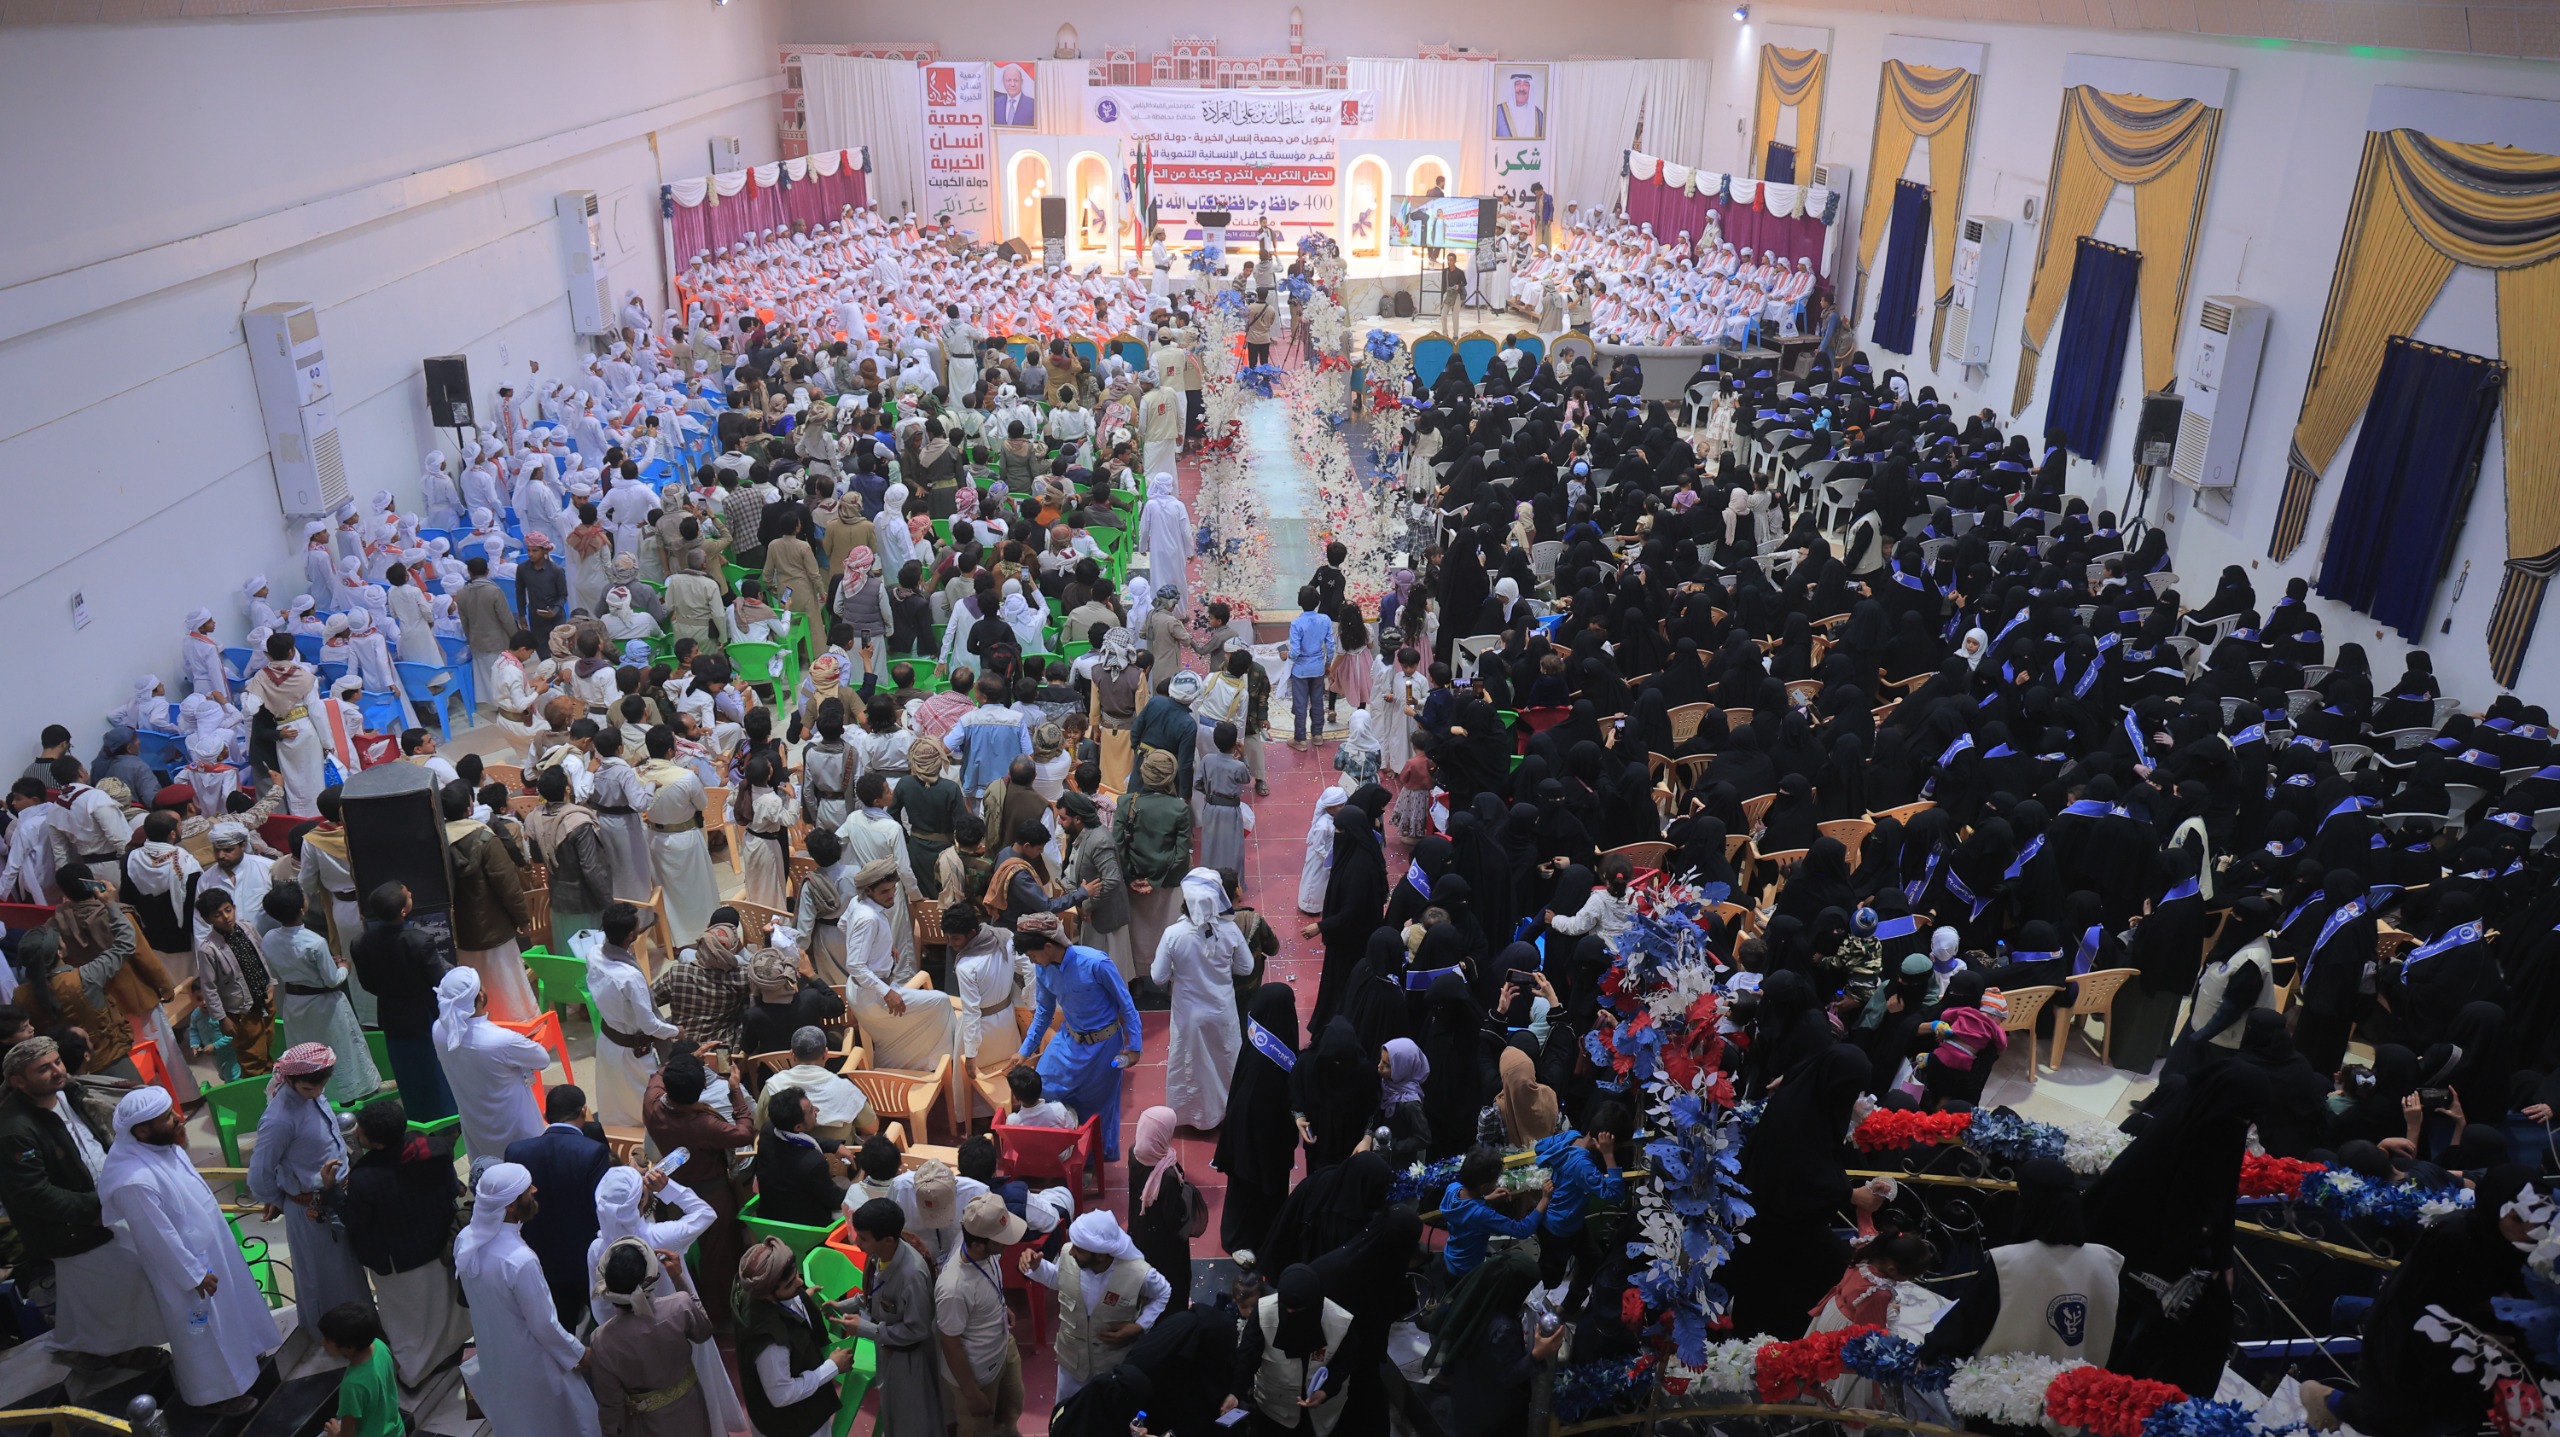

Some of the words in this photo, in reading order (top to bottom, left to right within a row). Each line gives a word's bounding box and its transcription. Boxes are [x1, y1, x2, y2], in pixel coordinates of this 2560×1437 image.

[960, 71, 981, 81] جمعية
[960, 93, 982, 103] الخيرية
[1309, 102, 1331, 112] برعاية
[928, 110, 982, 129] جمعية
[1311, 115, 1331, 124] اللواء
[930, 132, 983, 150] انسان
[1131, 133, 1162, 143] الكويت
[1164, 132, 1186, 143] دولة
[1194, 133, 1223, 144] الخيرية
[1225, 134, 1252, 144] إنسان
[1253, 134, 1283, 145] جمعية
[1285, 136, 1299, 145] من
[1301, 135, 1334, 145] بتمويل
[1160, 149, 1196, 160] التنموية
[1240, 151, 1267, 161] كافل
[1269, 151, 1306, 161] مؤسسة
[1308, 151, 1335, 161] تقيم
[931, 154, 984, 173] الخيرية
[1170, 170, 1186, 181] من
[1189, 168, 1221, 181] كوكبة
[1224, 169, 1253, 183] لتخرج
[1255, 170, 1300, 185] التكريمي
[1302, 171, 1332, 183] الحفل
[929, 176, 964, 189] الكويت
[966, 177, 988, 188] دولة
[1166, 192, 1185, 210] الله
[1303, 194, 1333, 210] 400
[1493, 185, 1537, 208] ويت
[1269, 195, 1300, 211] حافظ
